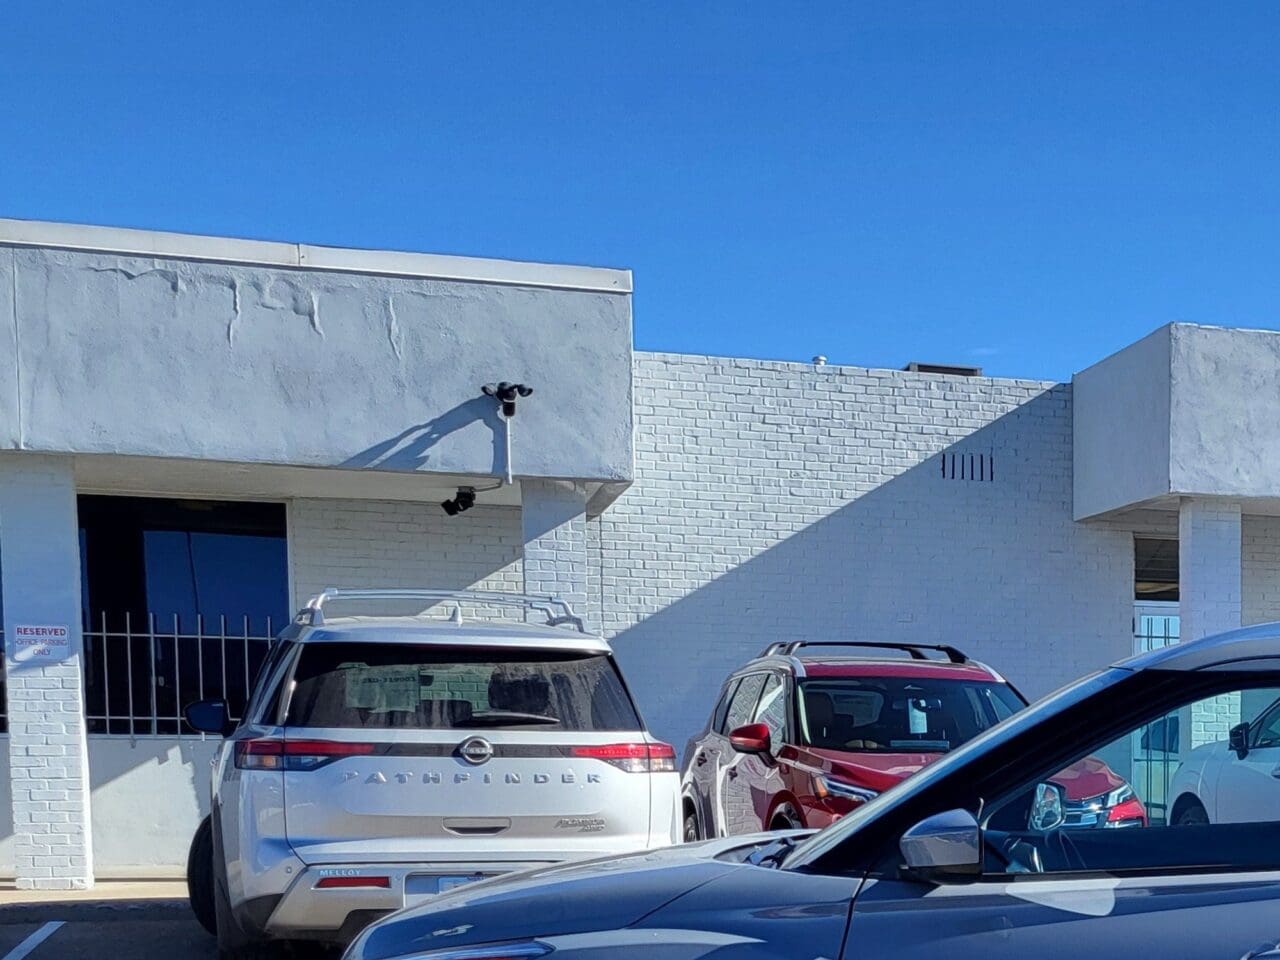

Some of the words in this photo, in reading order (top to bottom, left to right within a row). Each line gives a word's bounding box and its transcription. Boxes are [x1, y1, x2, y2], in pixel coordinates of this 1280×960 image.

[16, 627, 66, 636] RESERVED
[32, 648, 51, 656] ONLY
[345, 770, 602, 785] PATHFINDER
